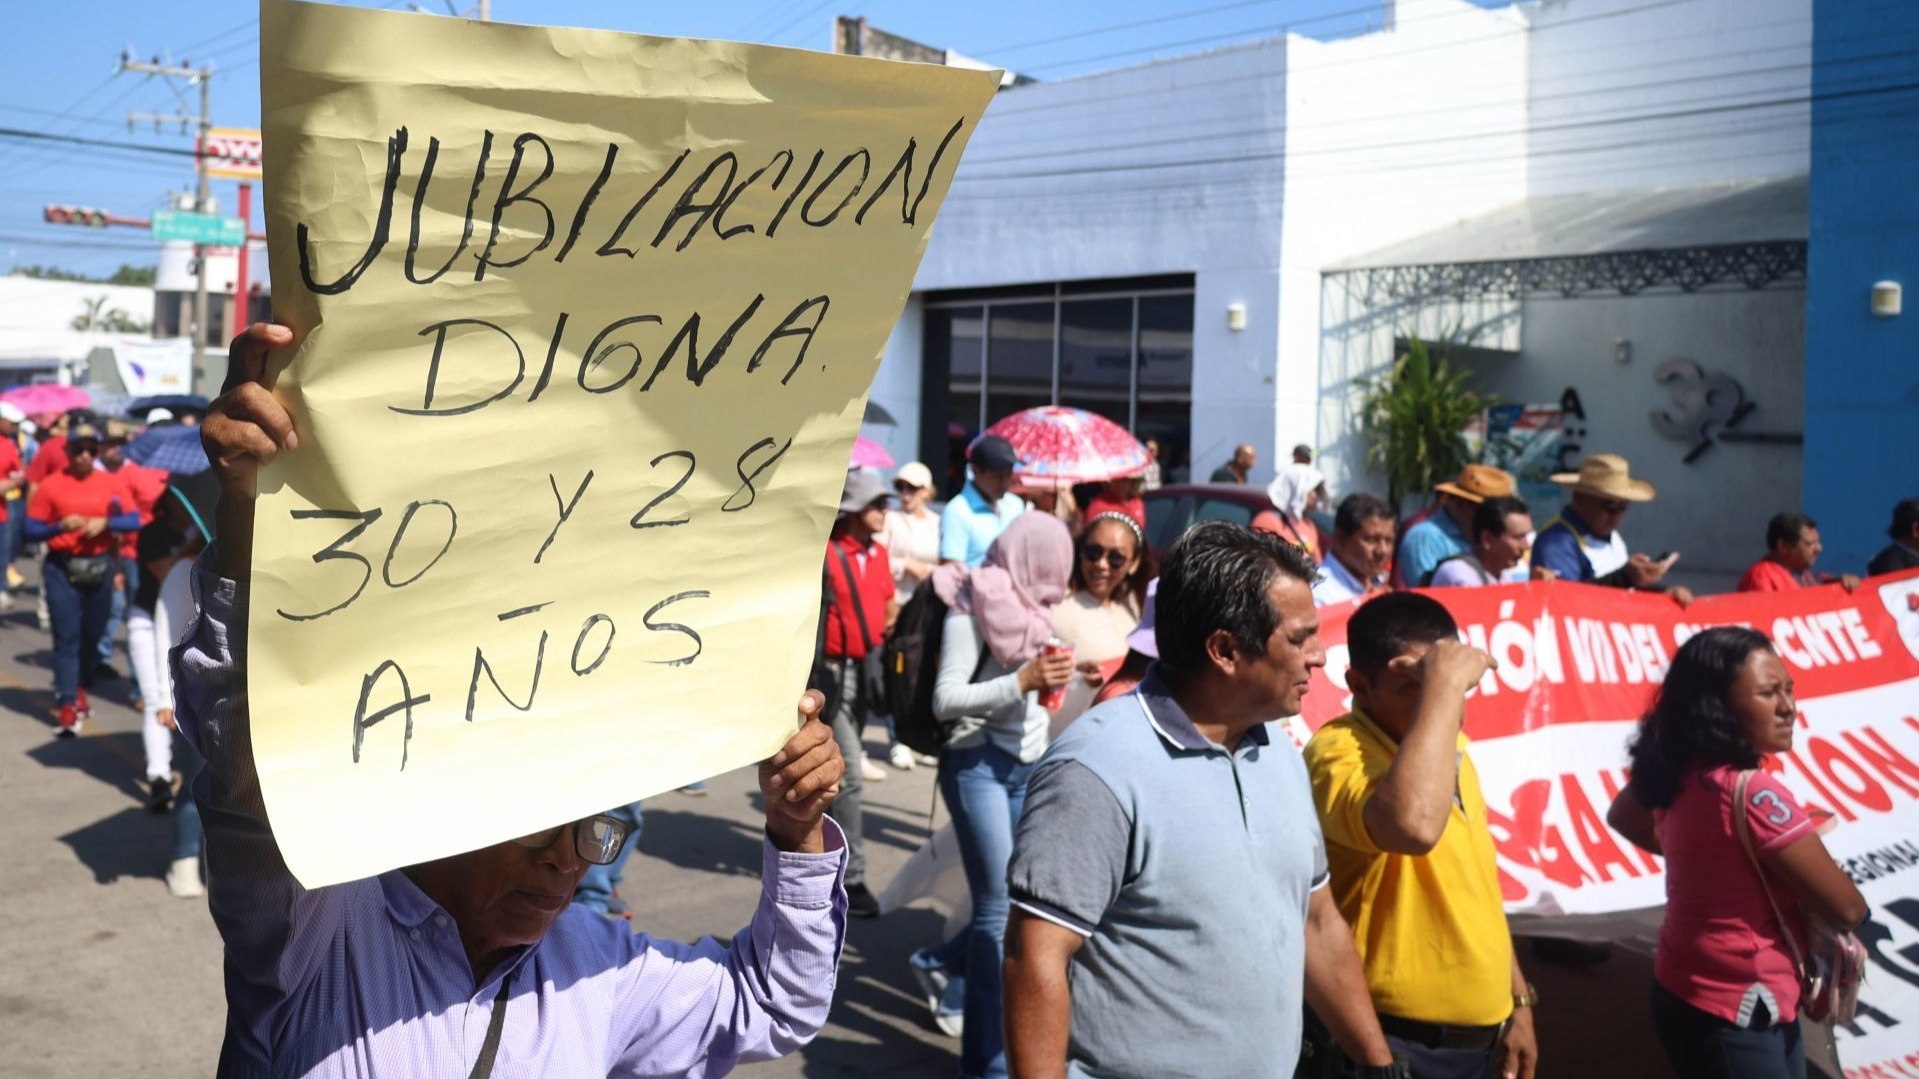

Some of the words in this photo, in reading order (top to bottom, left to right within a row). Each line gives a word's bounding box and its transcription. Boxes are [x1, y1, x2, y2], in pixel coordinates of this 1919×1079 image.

[298, 116, 966, 295] JUBILACION
[277, 499, 457, 622] 30
[533, 469, 594, 564] Y
[629, 437, 793, 530] 28
[352, 589, 710, 772] AÑOS
[1609, 621, 1671, 684] DEL
[1752, 788, 1794, 826] 3
